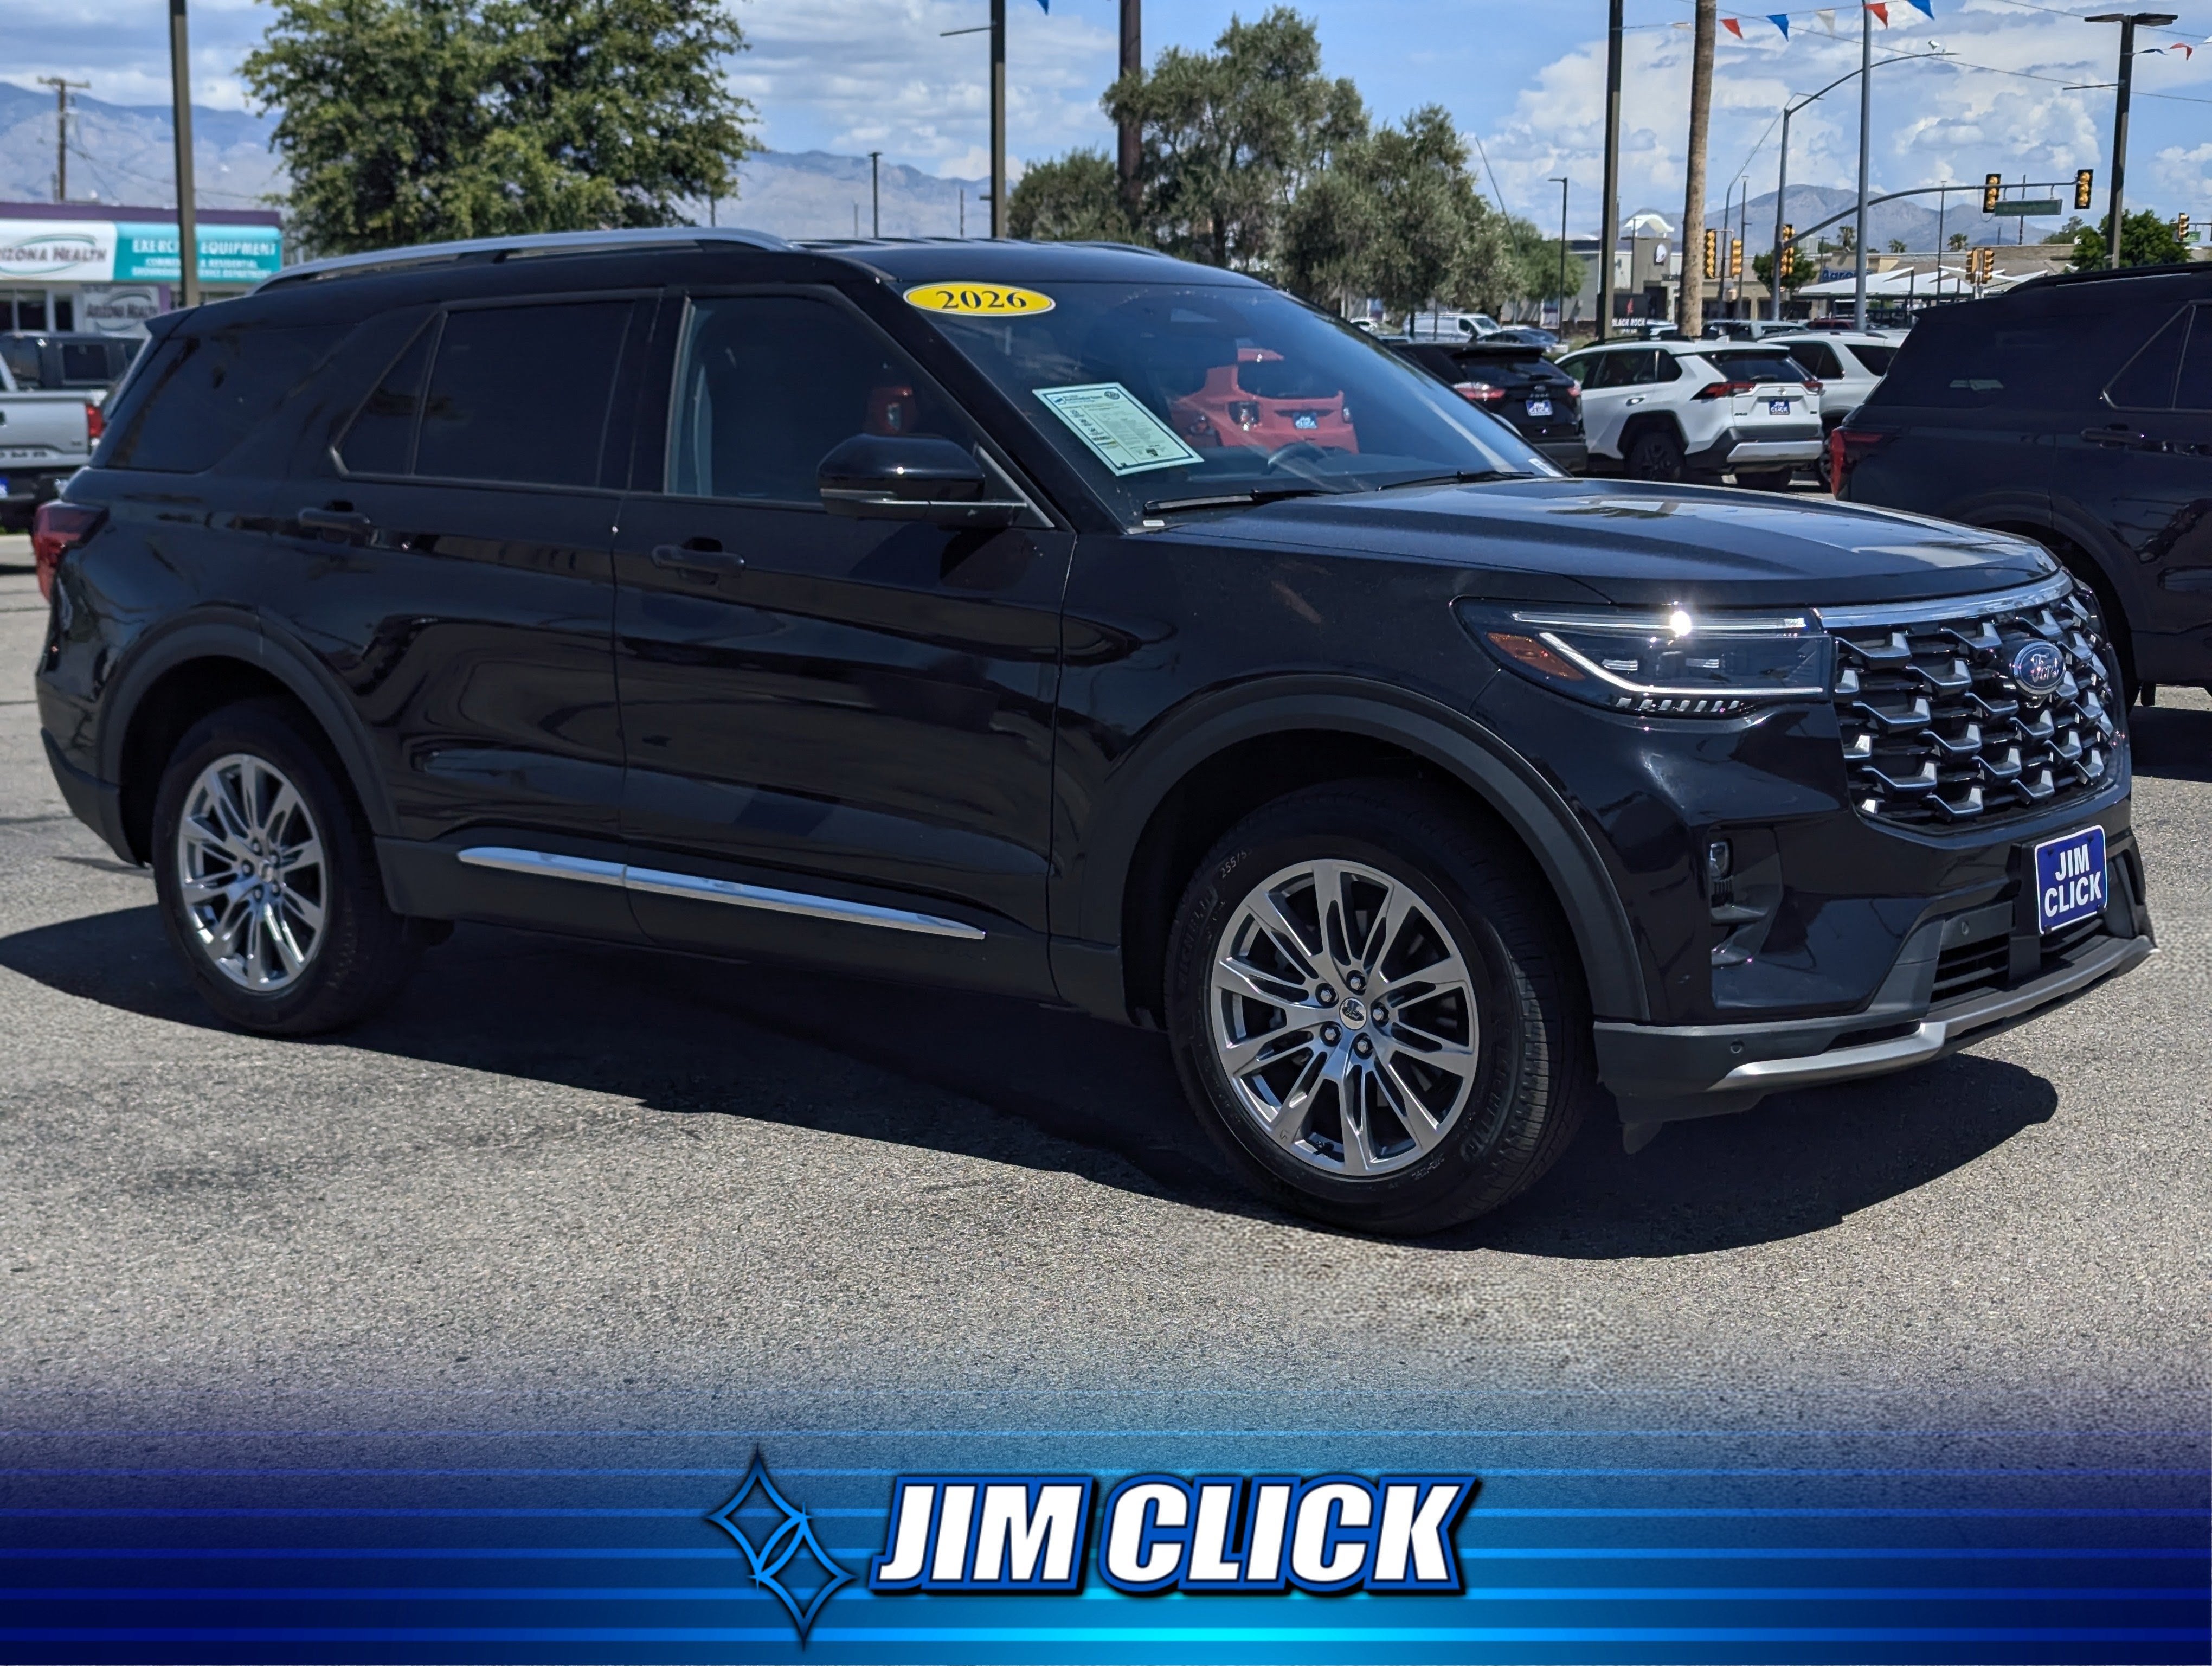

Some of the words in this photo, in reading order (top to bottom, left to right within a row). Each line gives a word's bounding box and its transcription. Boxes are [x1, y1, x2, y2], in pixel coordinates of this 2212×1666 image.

[0, 248, 48, 261] IZONA
[53, 247, 107, 262] HEALTH
[201, 242, 275, 256] EQUIPMENT
[936, 290, 1027, 309] 2026
[2028, 652, 2060, 683] Ford
[2055, 844, 2090, 881] JIM
[2044, 871, 2102, 917] CLICK
